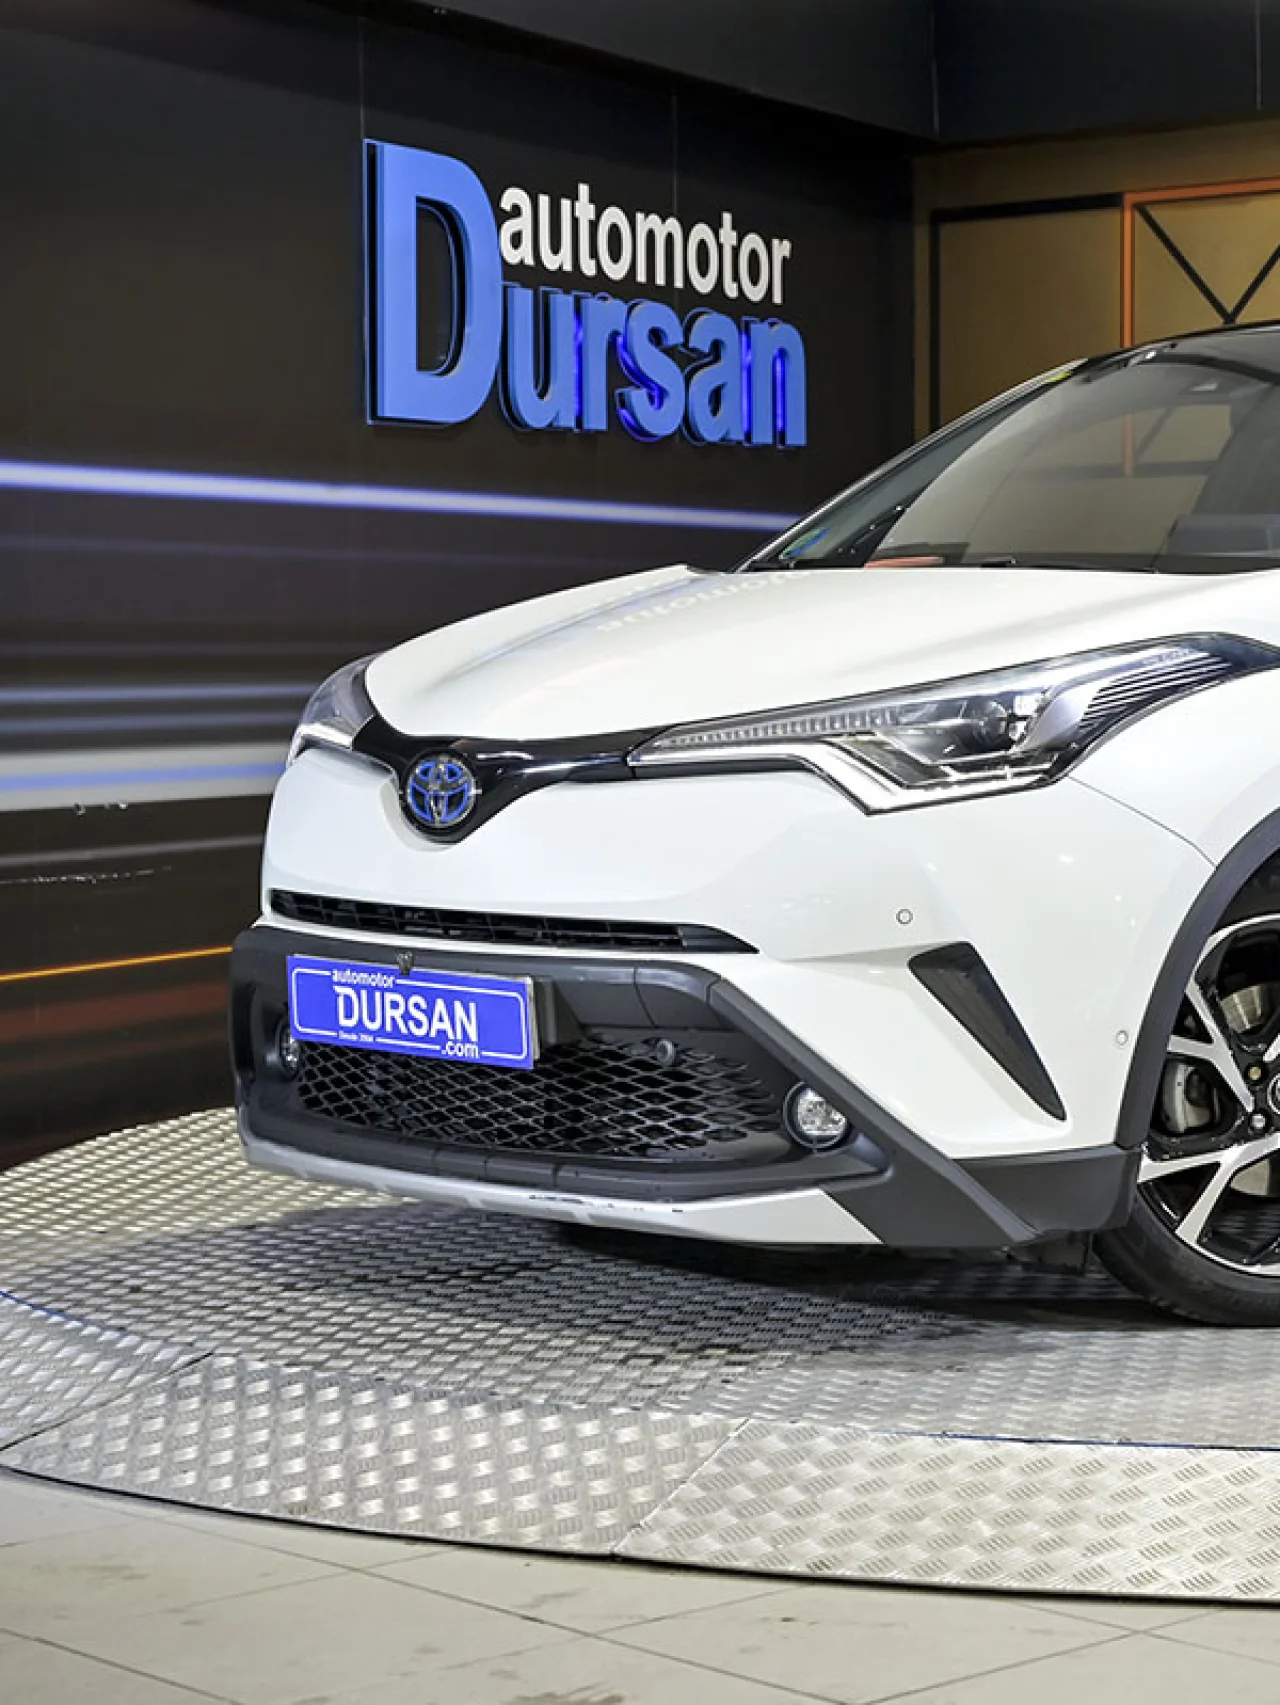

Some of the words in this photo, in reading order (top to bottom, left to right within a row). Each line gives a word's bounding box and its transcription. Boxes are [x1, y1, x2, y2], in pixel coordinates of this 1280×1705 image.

[500, 183, 792, 305] automotor
[363, 138, 807, 449] Dursan
[331, 968, 395, 989] automotor
[333, 985, 479, 1043] DURSAN
[441, 1040, 481, 1059] .com
